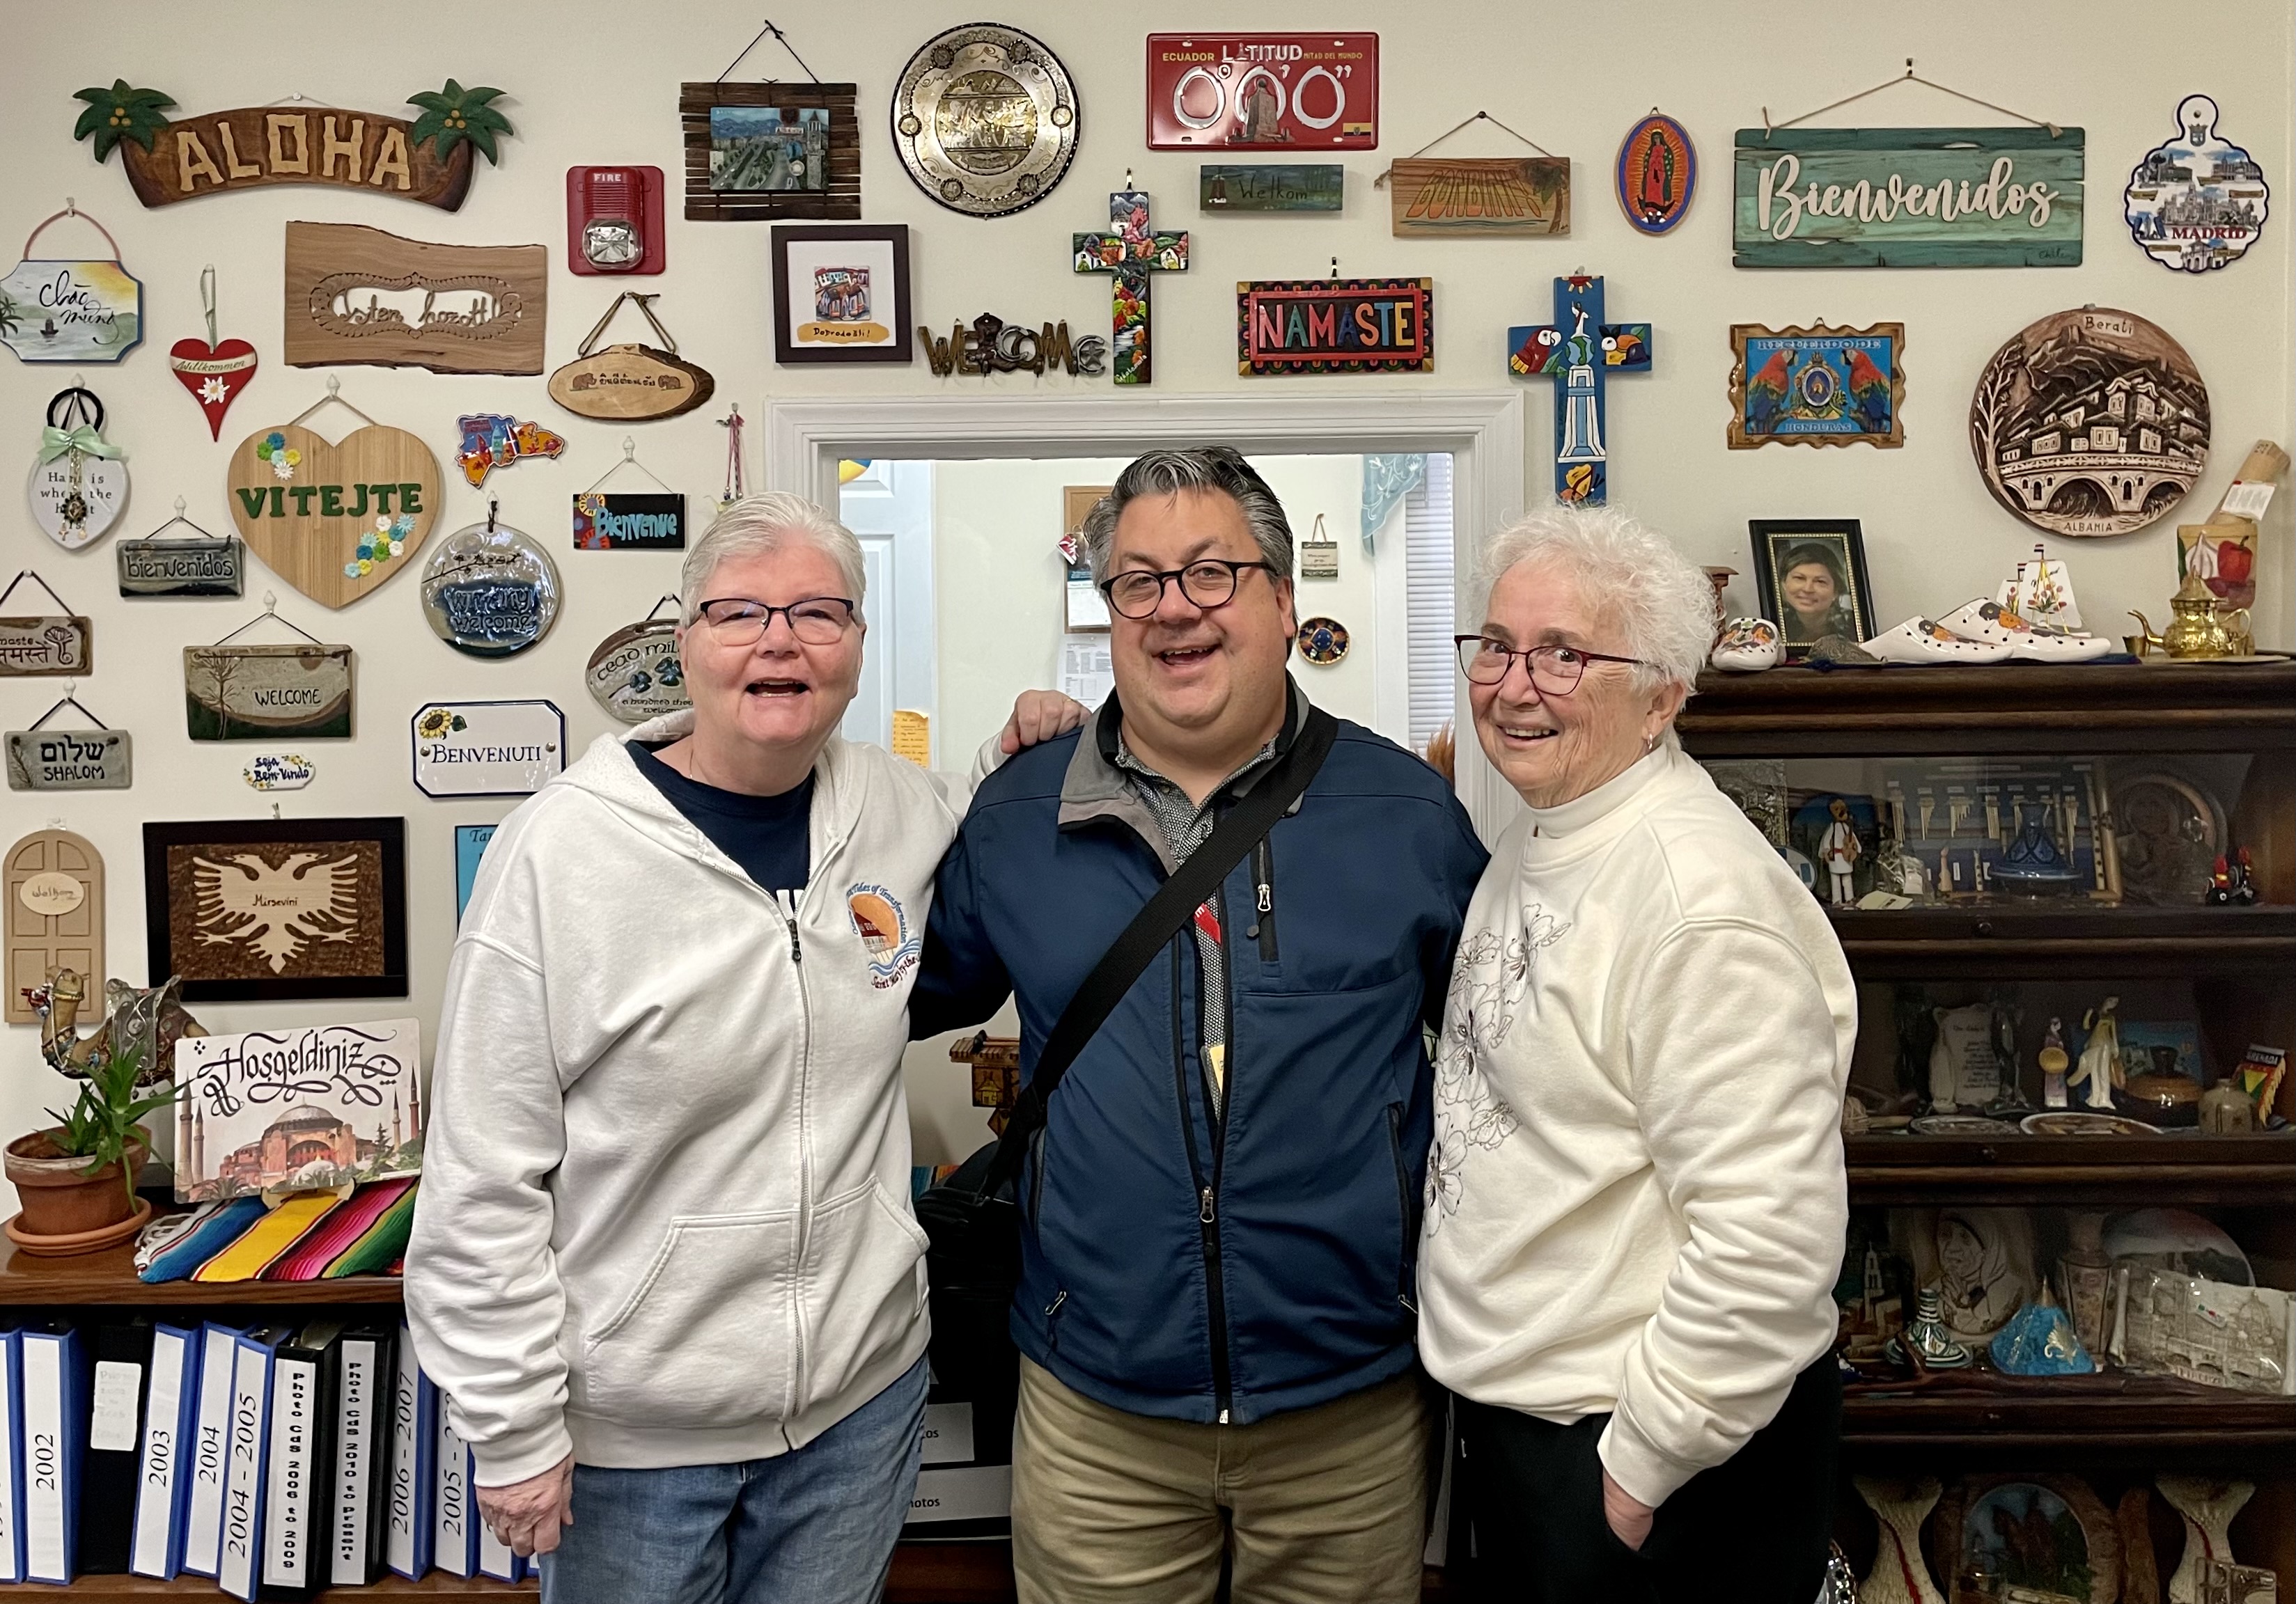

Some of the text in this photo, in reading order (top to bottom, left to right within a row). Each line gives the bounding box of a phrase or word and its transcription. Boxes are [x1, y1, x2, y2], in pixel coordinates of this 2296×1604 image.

[1163, 52, 1215, 61] ECUADOR
[176, 114, 412, 191] ALOHA
[594, 173, 621, 182] FIRE
[1238, 175, 1308, 200] Welkom
[1758, 154, 2059, 240] Bienvenidos
[2171, 227, 2247, 239] MADRID
[1259, 301, 1414, 348] NAMASTE
[2085, 316, 2134, 335] Berati
[1758, 339, 1881, 349] RECUERDO DE
[175, 360, 246, 372] Willkommen
[1786, 423, 1852, 432] HONDURAS
[91, 473, 104, 484] is
[90, 489, 111, 500] the
[237, 483, 423, 519] VITEJTE
[2063, 521, 2113, 533] ALBANIA
[127, 554, 233, 579] bienvenidos
[254, 689, 321, 707] WELCOME
[41, 735, 105, 762] שלום
[44, 765, 105, 782] SHALOM
[255, 757, 279, 771] Seja
[291, 1372, 305, 1417] Photo
[347, 1362, 362, 1403] Photo
[397, 1371, 414, 1441] 2007
[235, 1392, 257, 1463] 2005
[35, 1434, 54, 1491] 2002
[148, 1429, 171, 1487] 2003
[198, 1426, 221, 1484] 2004
[344, 1442, 358, 1478] 2010
[286, 1461, 300, 1499] 2006
[343, 1485, 356, 1500] to
[392, 1465, 410, 1536] 2006
[444, 1469, 462, 1537] 2005
[228, 1487, 251, 1559] 2004
[285, 1507, 297, 1523] to
